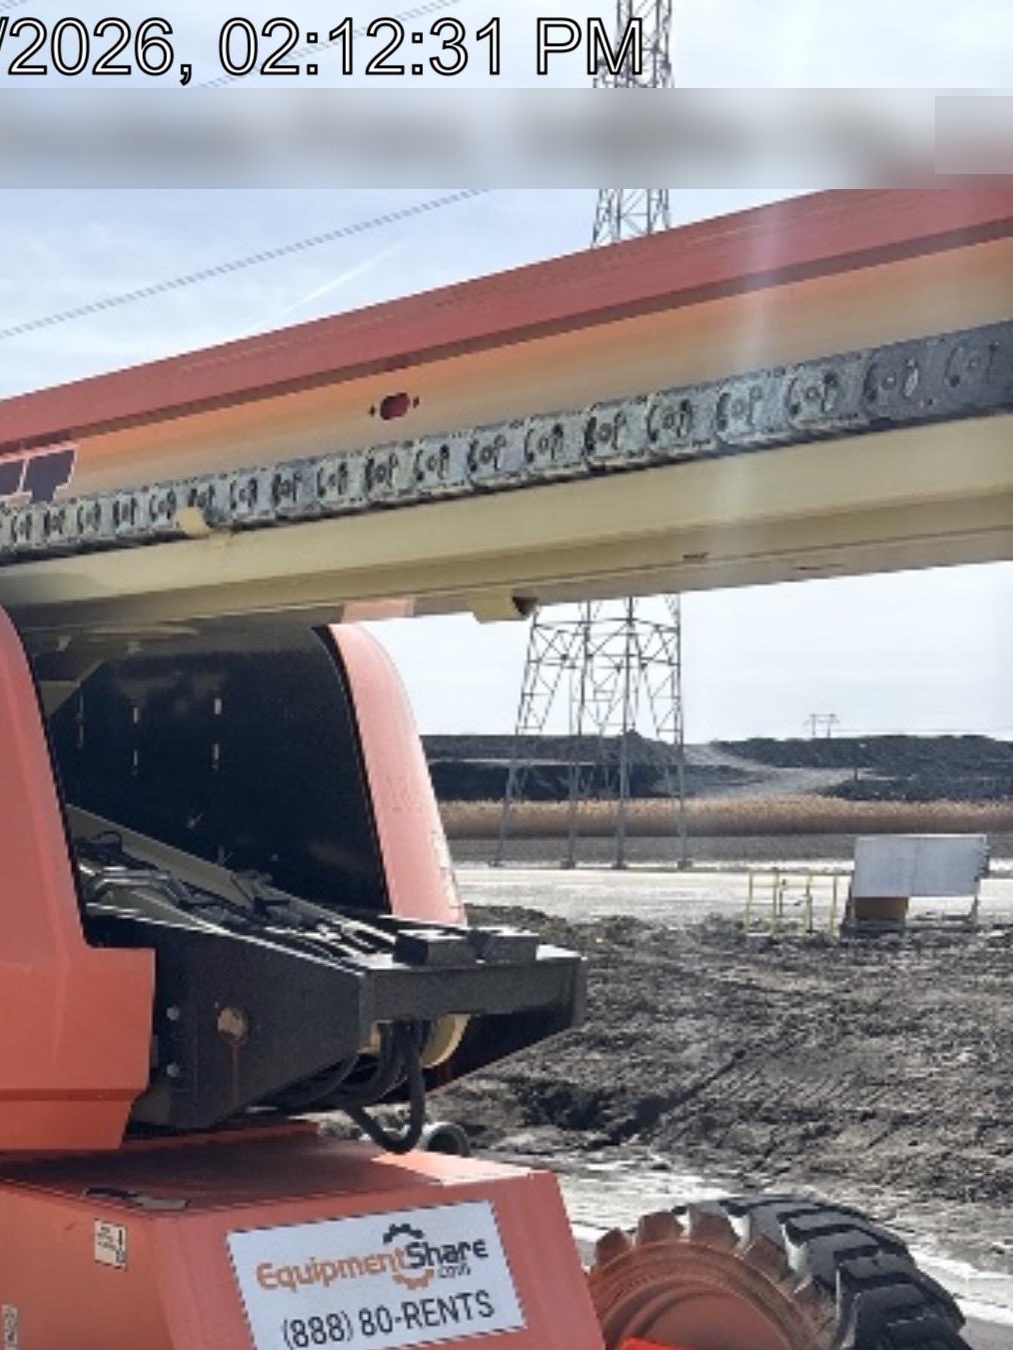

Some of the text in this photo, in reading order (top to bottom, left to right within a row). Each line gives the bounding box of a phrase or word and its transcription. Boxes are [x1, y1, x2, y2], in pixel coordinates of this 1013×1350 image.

[256, 1238, 489, 1292] EquipmentShare
[283, 1290, 495, 1350] (888) 80-RENTS
